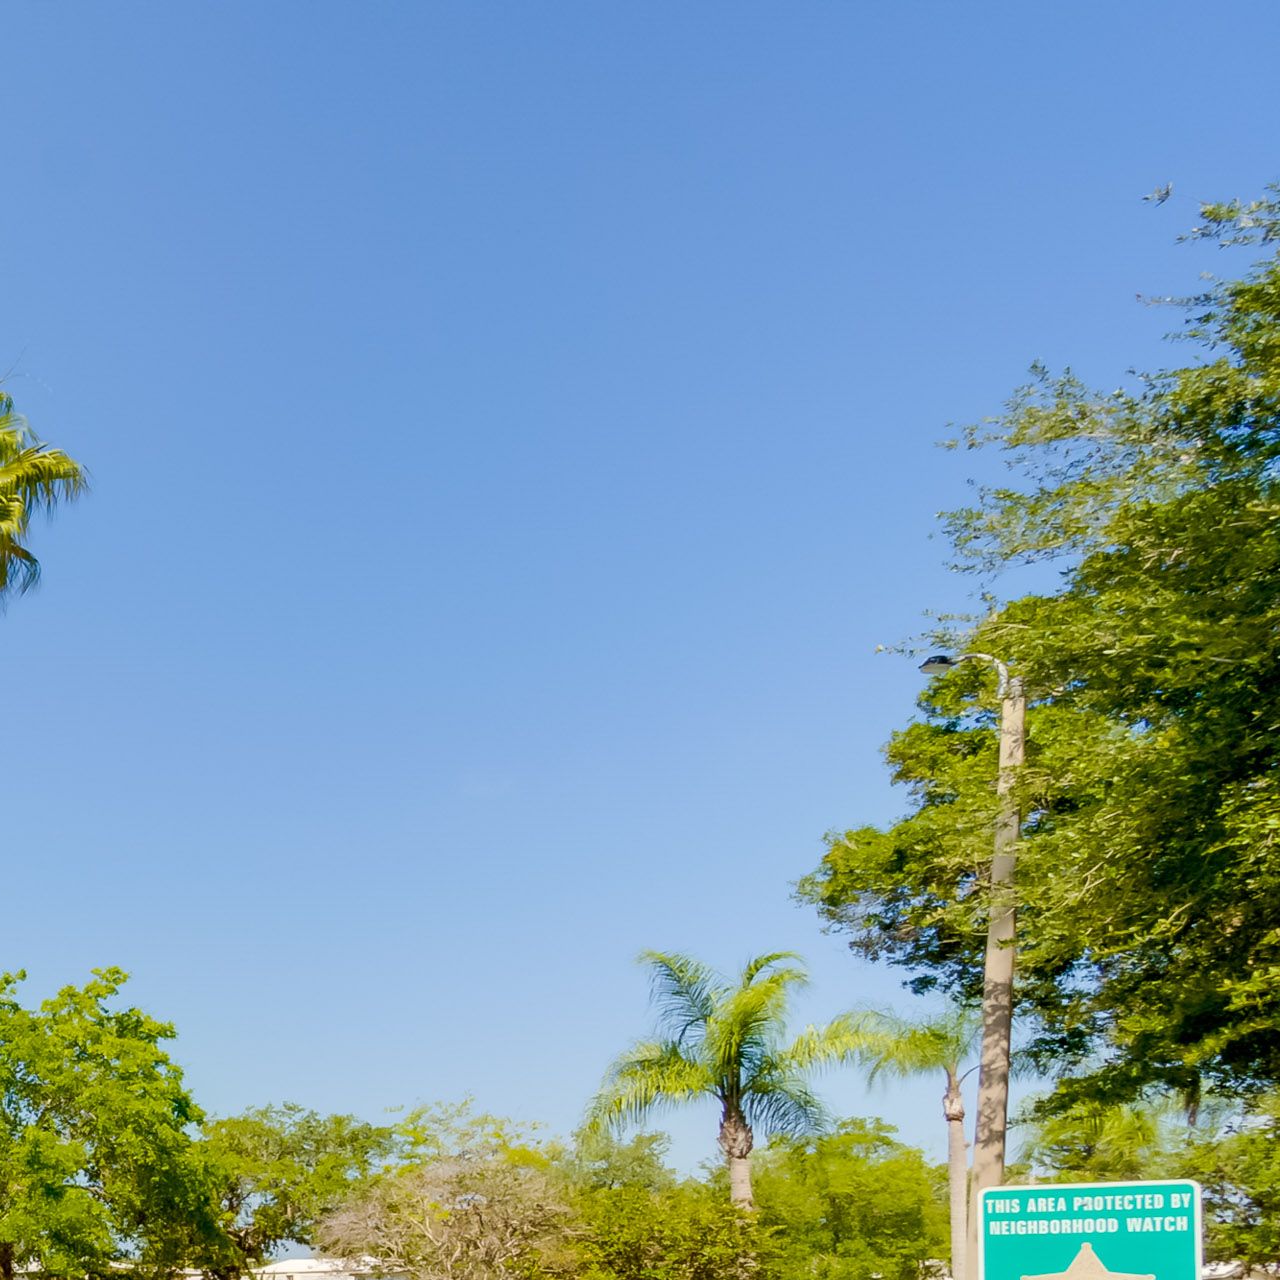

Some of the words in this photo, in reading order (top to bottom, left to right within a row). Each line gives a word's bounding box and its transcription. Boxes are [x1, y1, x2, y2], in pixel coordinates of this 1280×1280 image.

[986, 1199, 1020, 1214] THIS
[1026, 1197, 1067, 1213] AREA
[1073, 1194, 1164, 1211] PROTECTED
[1170, 1193, 1192, 1209] BY
[989, 1218, 1119, 1235] NEIGHBORHOOD
[1126, 1216, 1189, 1232] WATCH
